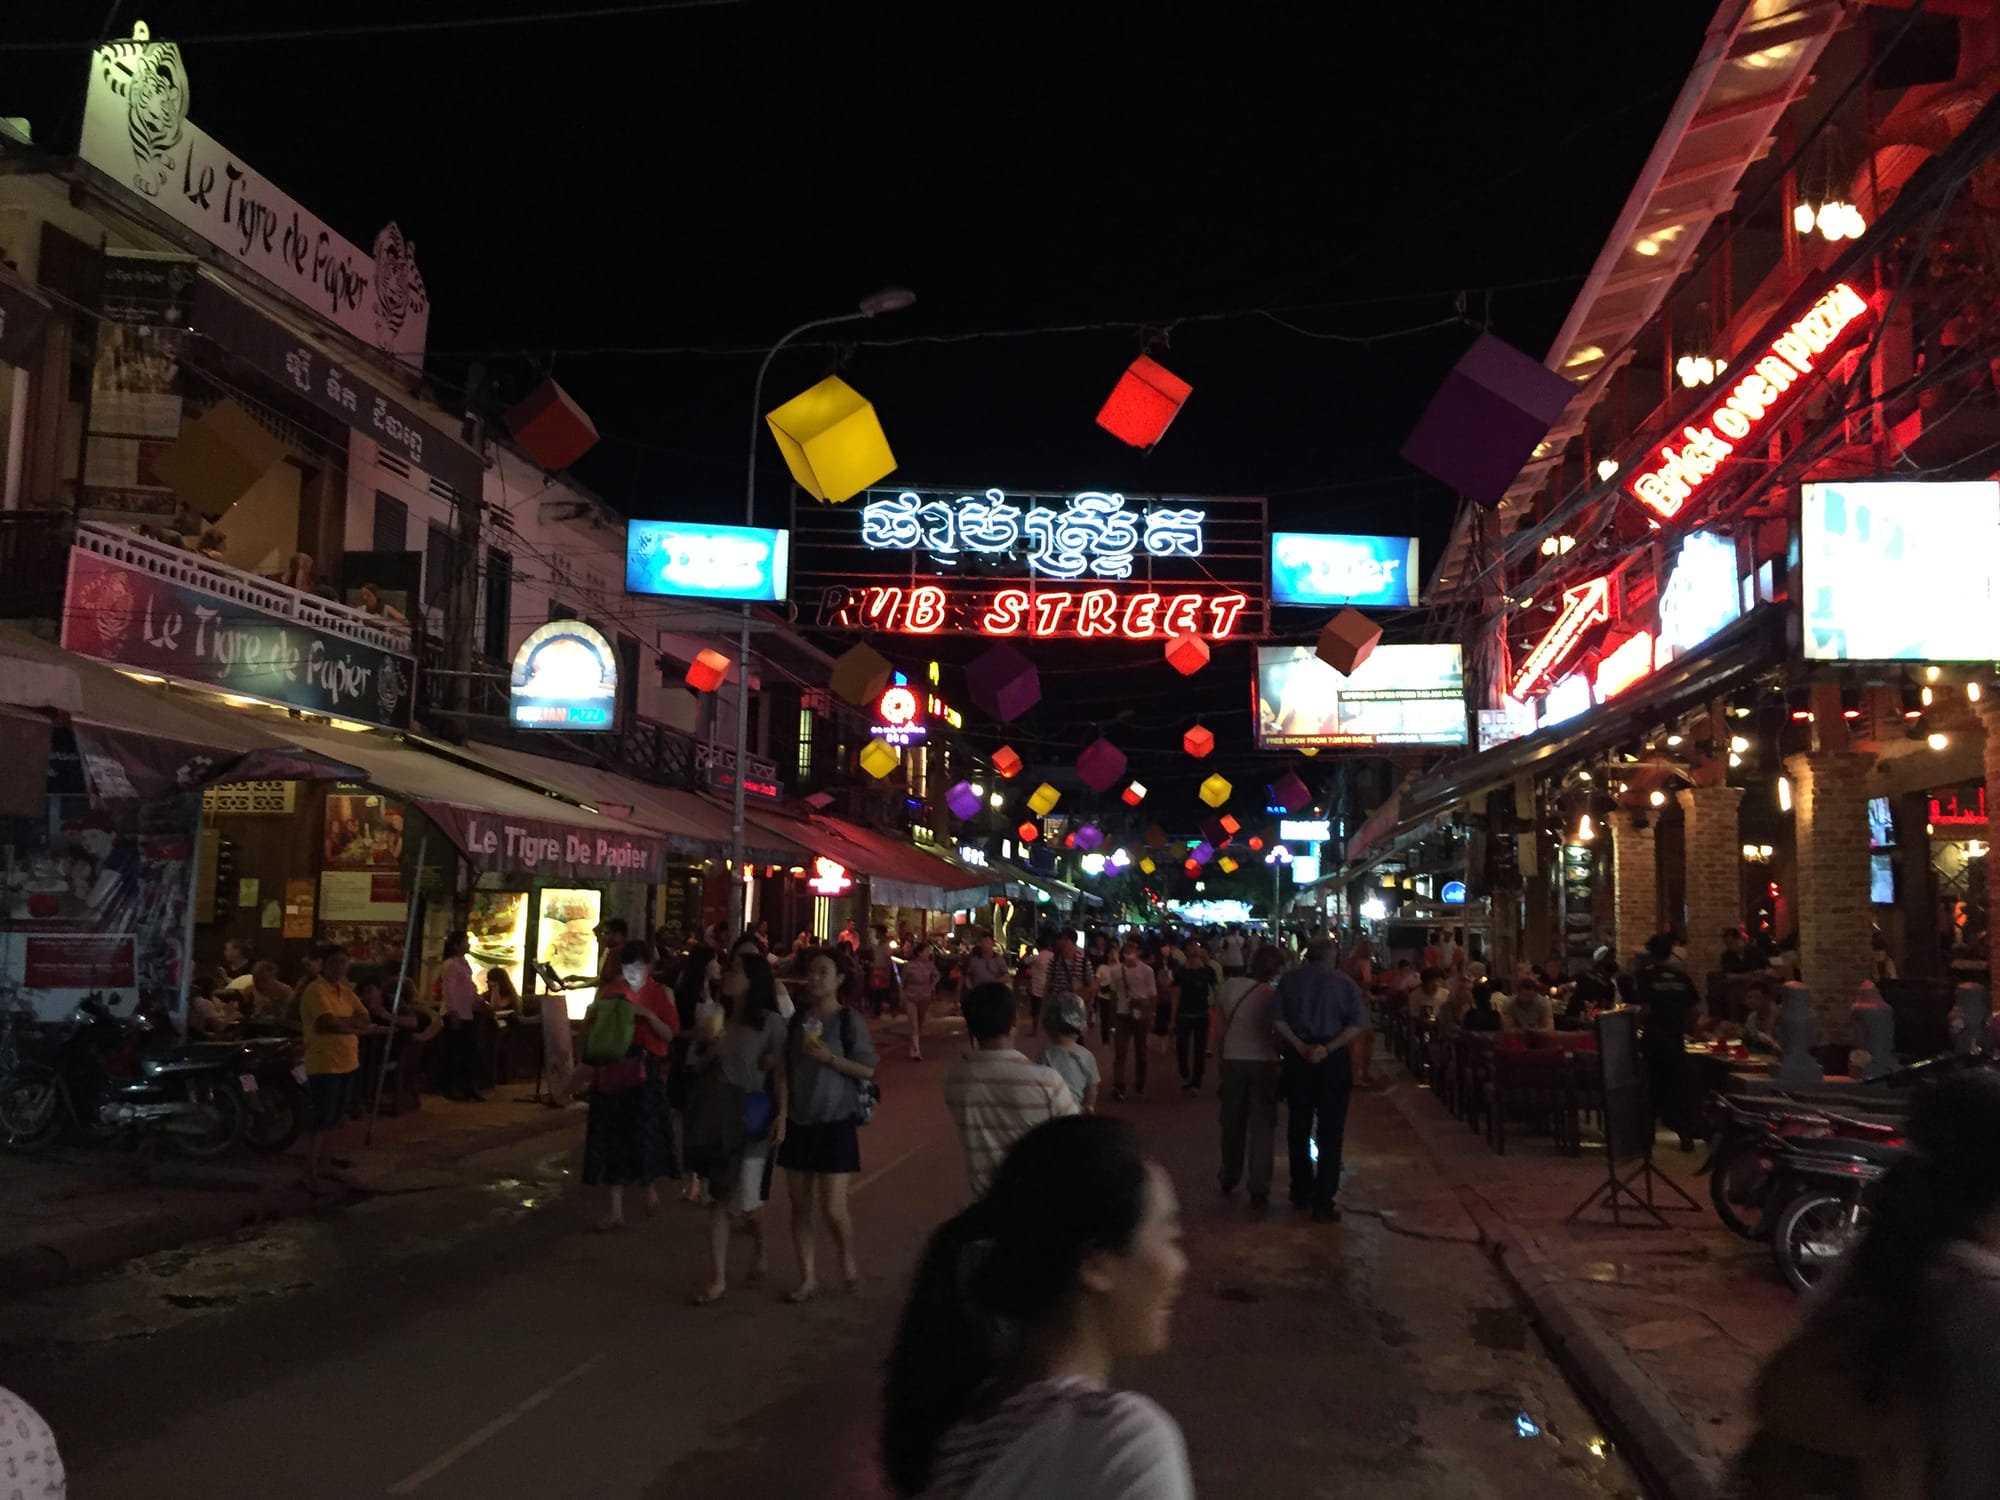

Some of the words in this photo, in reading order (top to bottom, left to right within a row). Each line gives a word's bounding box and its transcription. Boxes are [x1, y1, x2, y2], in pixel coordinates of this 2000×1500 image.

[184, 138, 214, 209] Le
[224, 162, 277, 255] Tigre
[284, 213, 308, 274] de
[313, 232, 368, 313] Papier
[1634, 427, 1733, 517] Brick
[1713, 356, 1799, 438] oven
[143, 593, 182, 650] Le
[193, 604, 260, 679] Tigre
[270, 630, 299, 682] de
[307, 640, 372, 704] Papier
[983, 589, 1247, 638] STREET
[568, 706, 606, 723] PIZZA
[467, 820, 497, 854] Le
[504, 825, 560, 867] Tigre
[565, 834, 591, 865] De
[596, 839, 648, 874] Papier
